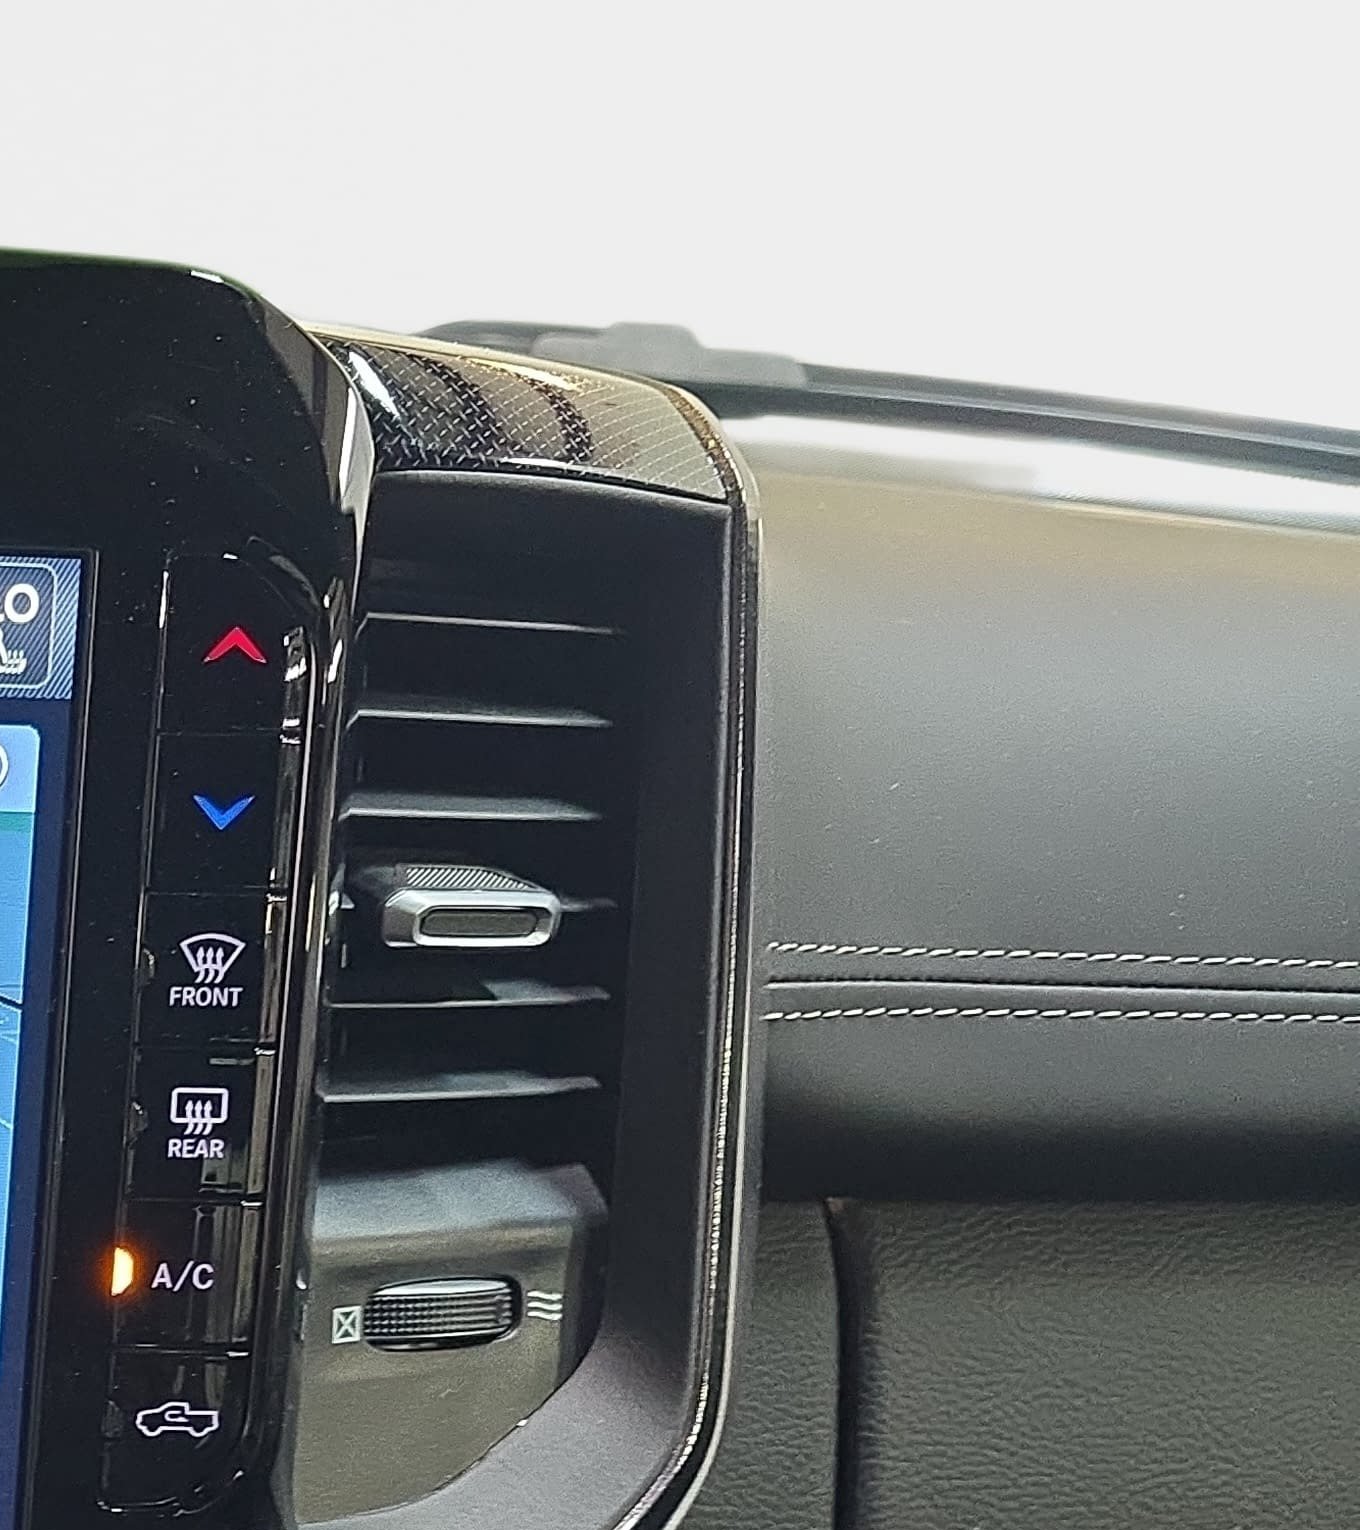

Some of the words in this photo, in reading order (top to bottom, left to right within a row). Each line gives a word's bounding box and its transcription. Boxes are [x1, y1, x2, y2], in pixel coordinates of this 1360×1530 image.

[169, 986, 243, 1007] FRONT
[167, 1138, 225, 1159] REAR
[151, 1262, 215, 1291] A/C
